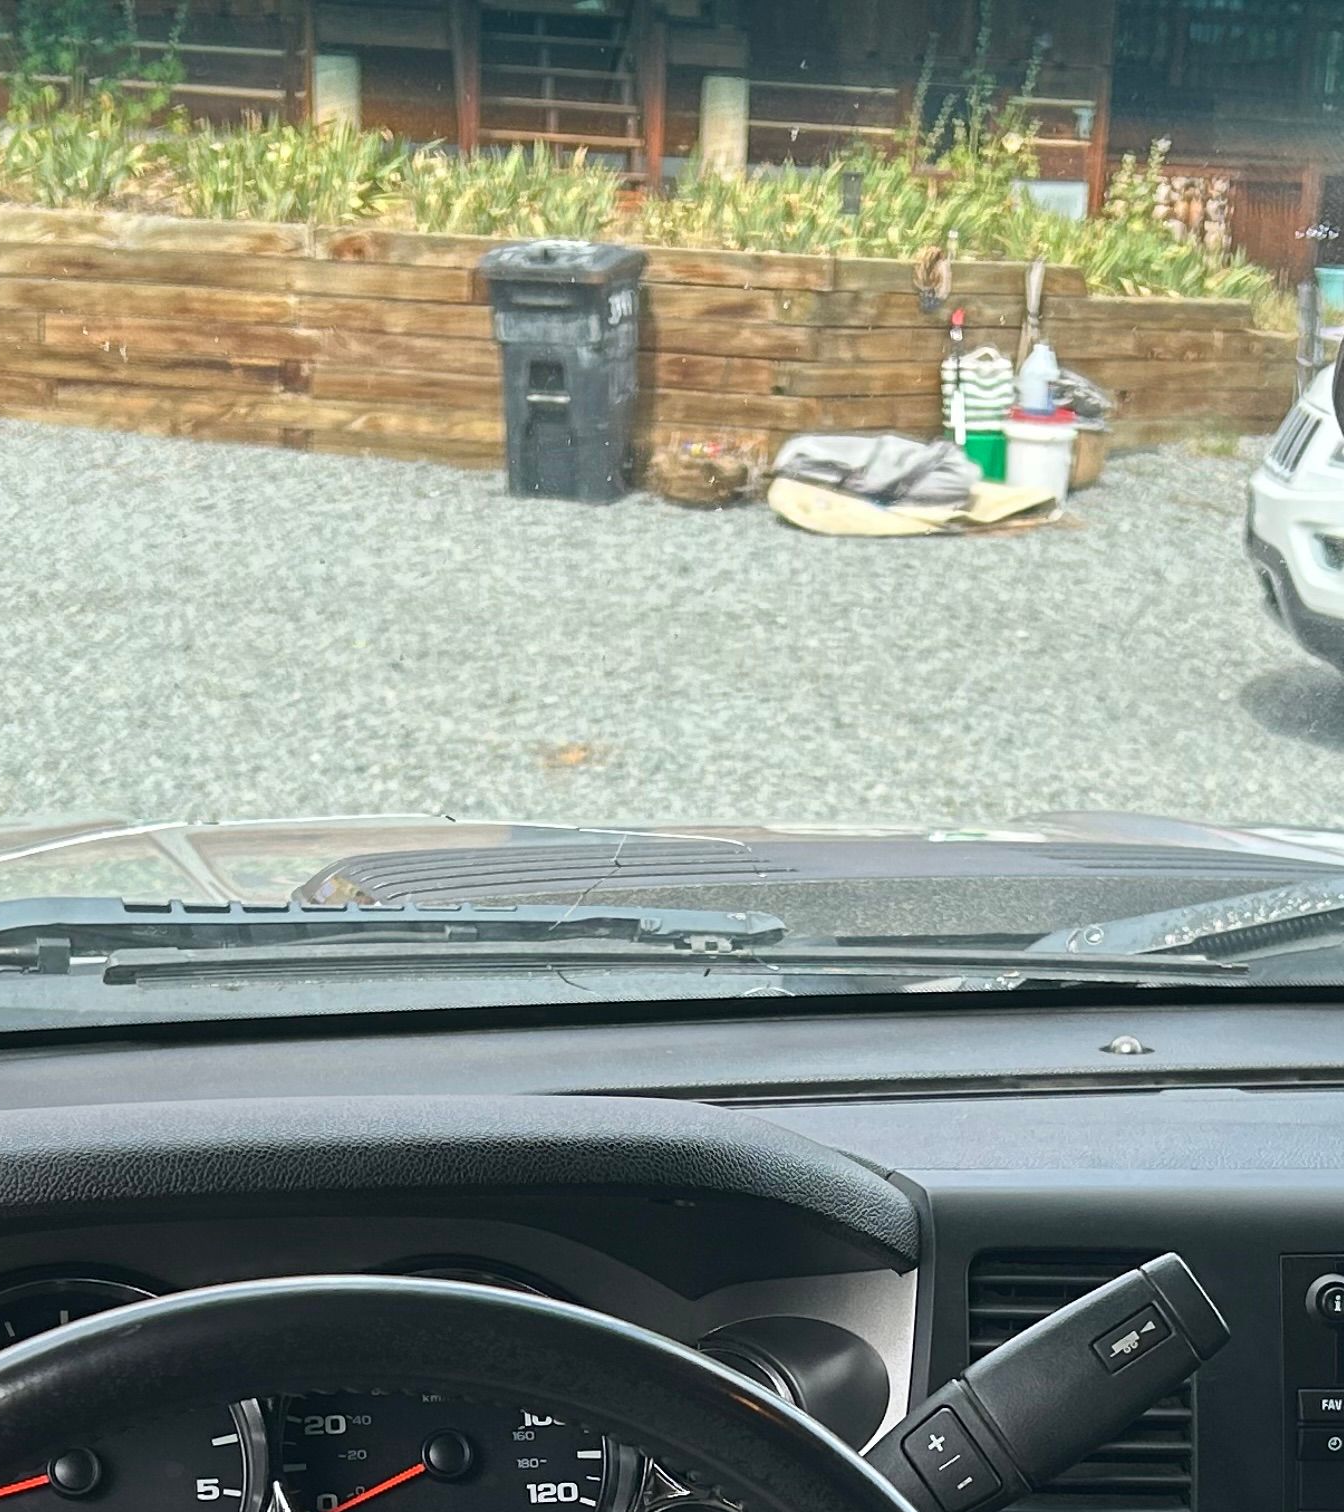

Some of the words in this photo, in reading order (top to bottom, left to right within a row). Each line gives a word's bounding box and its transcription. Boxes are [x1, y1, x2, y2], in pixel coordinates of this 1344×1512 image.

[1321, 1399, 1344, 1412] FAV
[303, 1414, 348, 1435] 20
[352, 1415, 372, 1425] 40
[512, 1431, 535, 1441] 160
[516, 1458, 540, 1469] 180
[196, 1478, 220, 1500] 5
[526, 1482, 579, 1503] 120
[316, 1493, 338, 1512] 0
